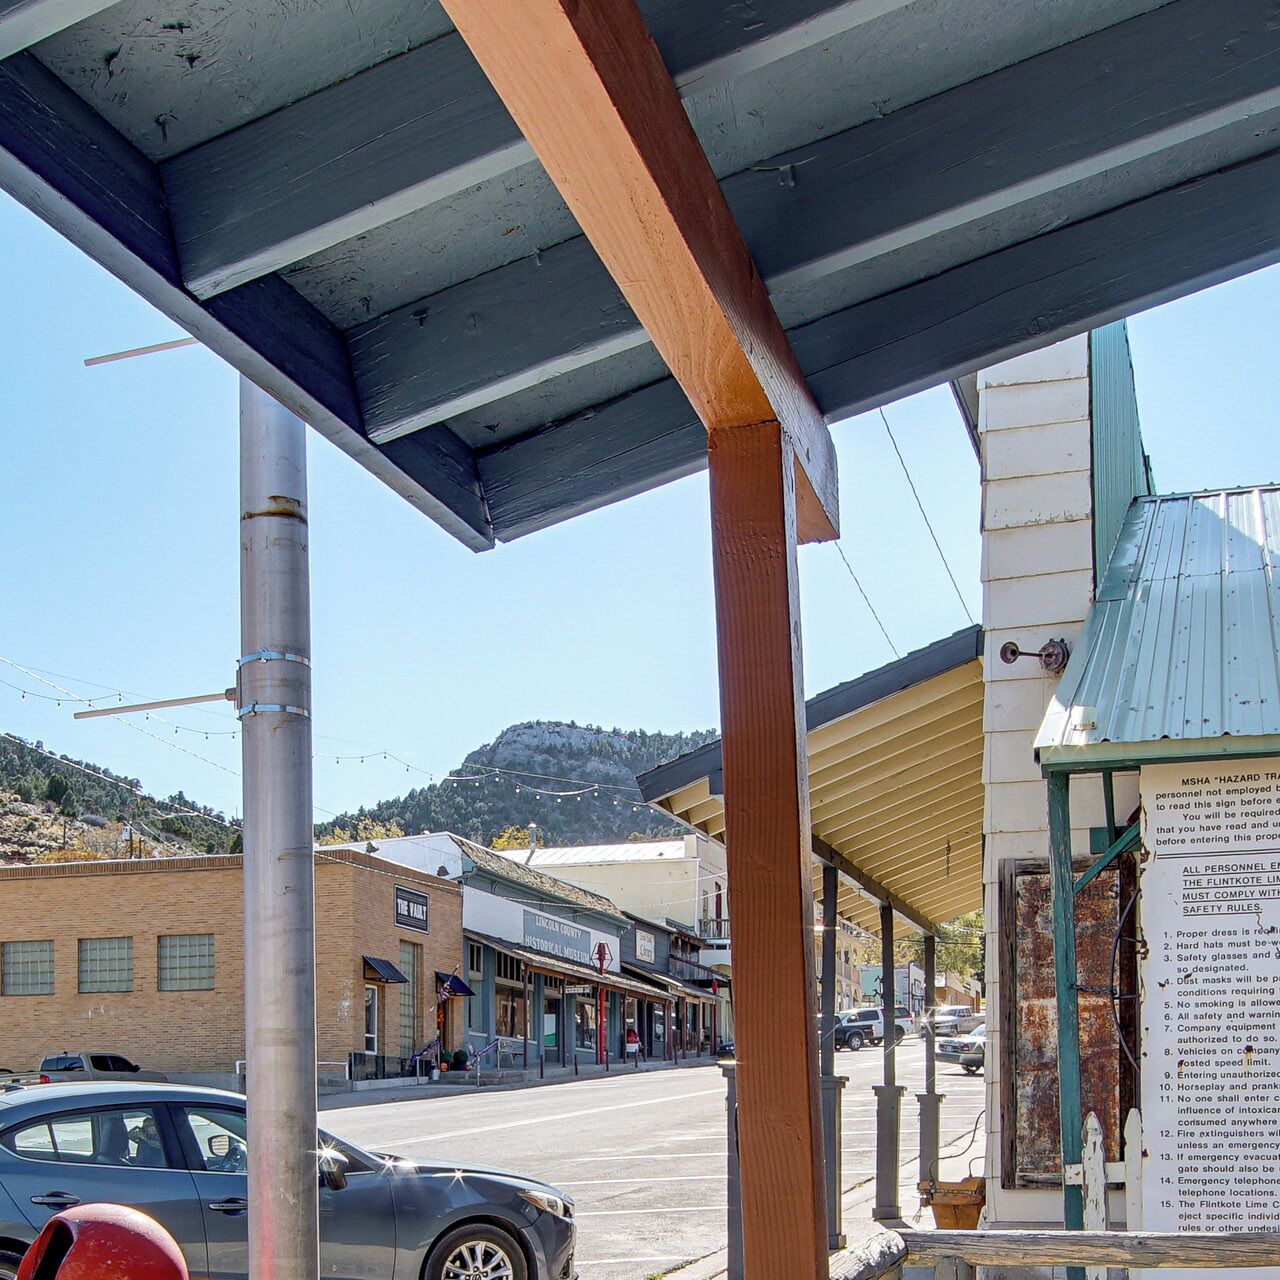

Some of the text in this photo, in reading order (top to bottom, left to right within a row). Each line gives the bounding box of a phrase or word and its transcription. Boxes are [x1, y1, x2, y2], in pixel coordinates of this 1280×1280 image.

[1181, 777, 1211, 785] MSHA
[1156, 787, 1202, 801] personnel
[1206, 786, 1222, 796] not
[1226, 784, 1272, 797] employed
[1156, 801, 1166, 810] to
[1169, 800, 1191, 809] read
[1194, 799, 1212, 808] this
[1216, 797, 1236, 809] sign
[1240, 796, 1272, 806] before
[1182, 811, 1201, 820] You
[1204, 810, 1221, 819] will
[1224, 809, 1237, 818] be
[1240, 807, 1280, 820] required
[1156, 824, 1175, 834] that
[1178, 825, 1196, 835] you
[1199, 822, 1222, 832] have
[1225, 820, 1247, 830] read
[1251, 819, 1269, 829] and
[1156, 835, 1186, 846] before
[1190, 833, 1230, 846] entering
[1234, 832, 1252, 842] this
[1182, 865, 1201, 874] ALL
[1204, 863, 1266, 873] PERSONNEL
[1182, 878, 1203, 886] THE
[1207, 876, 1263, 885] FLINTKOTE
[1182, 891, 1210, 900] MUST
[1214, 890, 1255, 899] COMPLY
[398, 900, 426, 920] THE VAULT
[1182, 903, 1263, 914] SAFETY RULES.
[536, 916, 582, 940] LINCOLN COUNTY
[525, 936, 590, 964] HISTORICAL MUSEUM
[1177, 986, 1227, 996] conditions
[1231, 985, 1275, 997] requiring
[1177, 999, 1191, 1008] No
[1194, 998, 1234, 1010] smoking
[1238, 998, 1247, 1006] is
[1177, 1011, 1190, 1019] All
[1193, 1010, 1223, 1021] safety
[1226, 1010, 1245, 1019] and
[1177, 1081, 1226, 1092] Horseplay
[1229, 1081, 1248, 1090] and
[1231, 1117, 1278, 1128] anywhere
[1178, 1176, 1231, 1187] Emergency
[1178, 1188, 1278, 1198] telephone locations.
